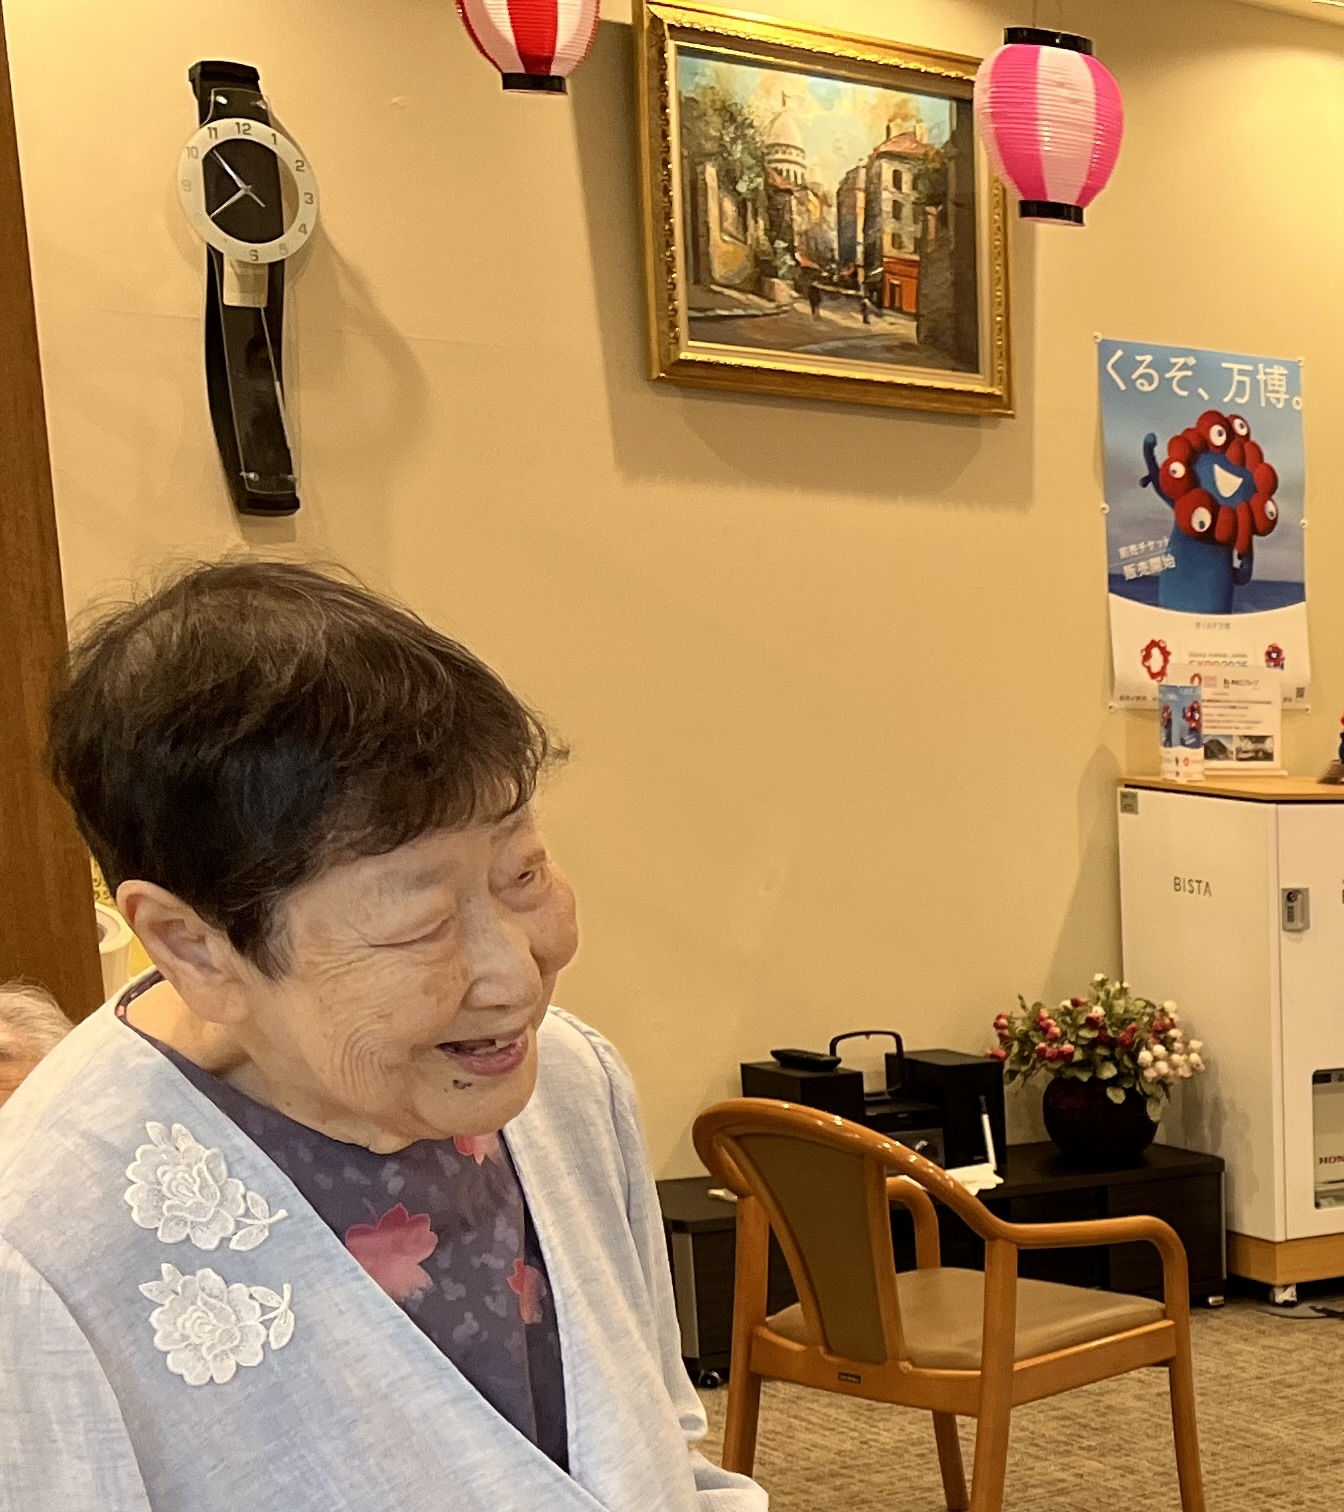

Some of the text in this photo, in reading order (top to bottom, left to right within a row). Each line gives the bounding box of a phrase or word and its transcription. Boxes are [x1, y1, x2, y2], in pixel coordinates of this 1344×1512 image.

[207, 126, 218, 140] 11
[236, 122, 252, 136] 12
[295, 160, 306, 172] 2
[304, 192, 314, 205] 3
[298, 223, 308, 236] 4
[1105, 347, 1303, 412] くるぞ、万博。
[1173, 876, 1213, 897] BISTA
